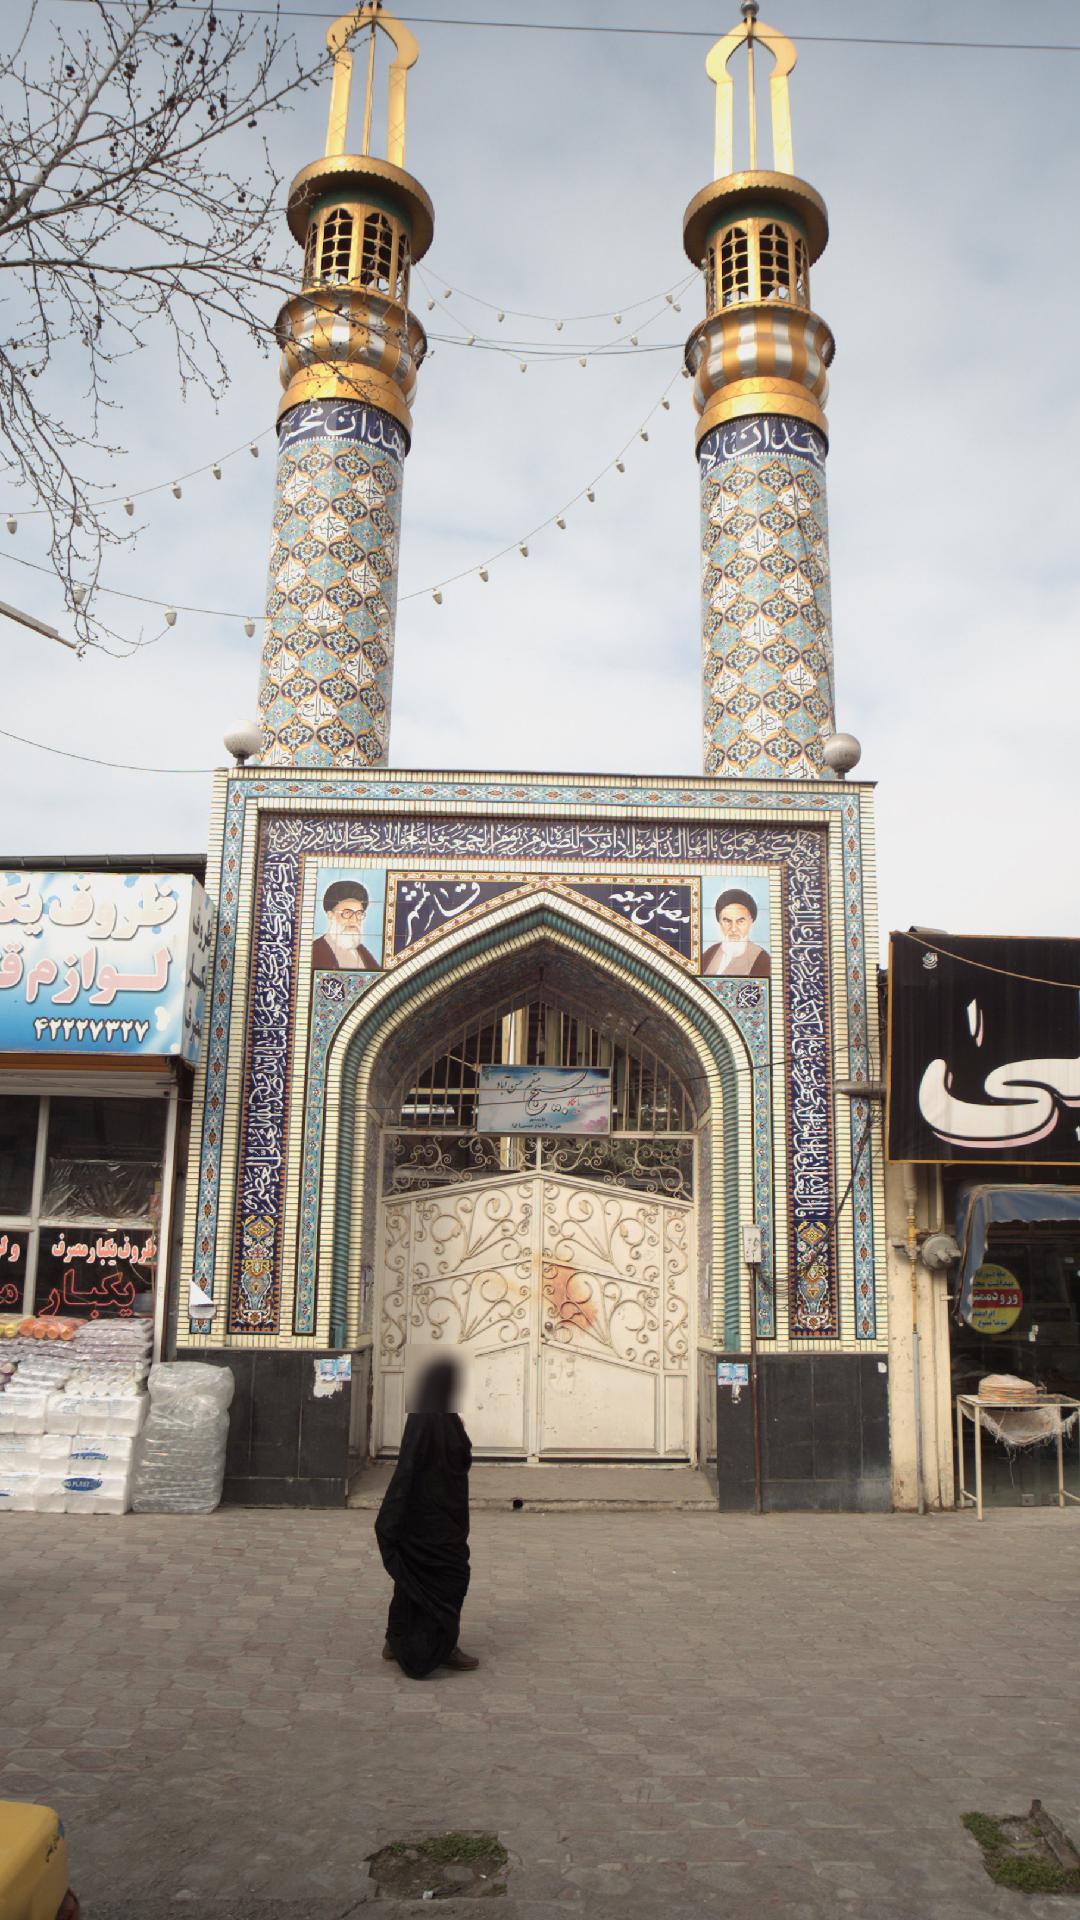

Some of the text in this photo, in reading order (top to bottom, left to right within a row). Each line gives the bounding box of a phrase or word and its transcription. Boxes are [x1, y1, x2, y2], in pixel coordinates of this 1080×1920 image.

[49, 883, 178, 940] ظروف
[26, 945, 173, 1005] لوازم
[34, 1016, 150, 1043] ۴۲۲۲۷۳۲۷
[51, 1232, 88, 1263] مصرف
[86, 1237, 118, 1265] یکبار
[118, 1235, 157, 1264] ظروف
[38, 1268, 136, 1318] یکبار
